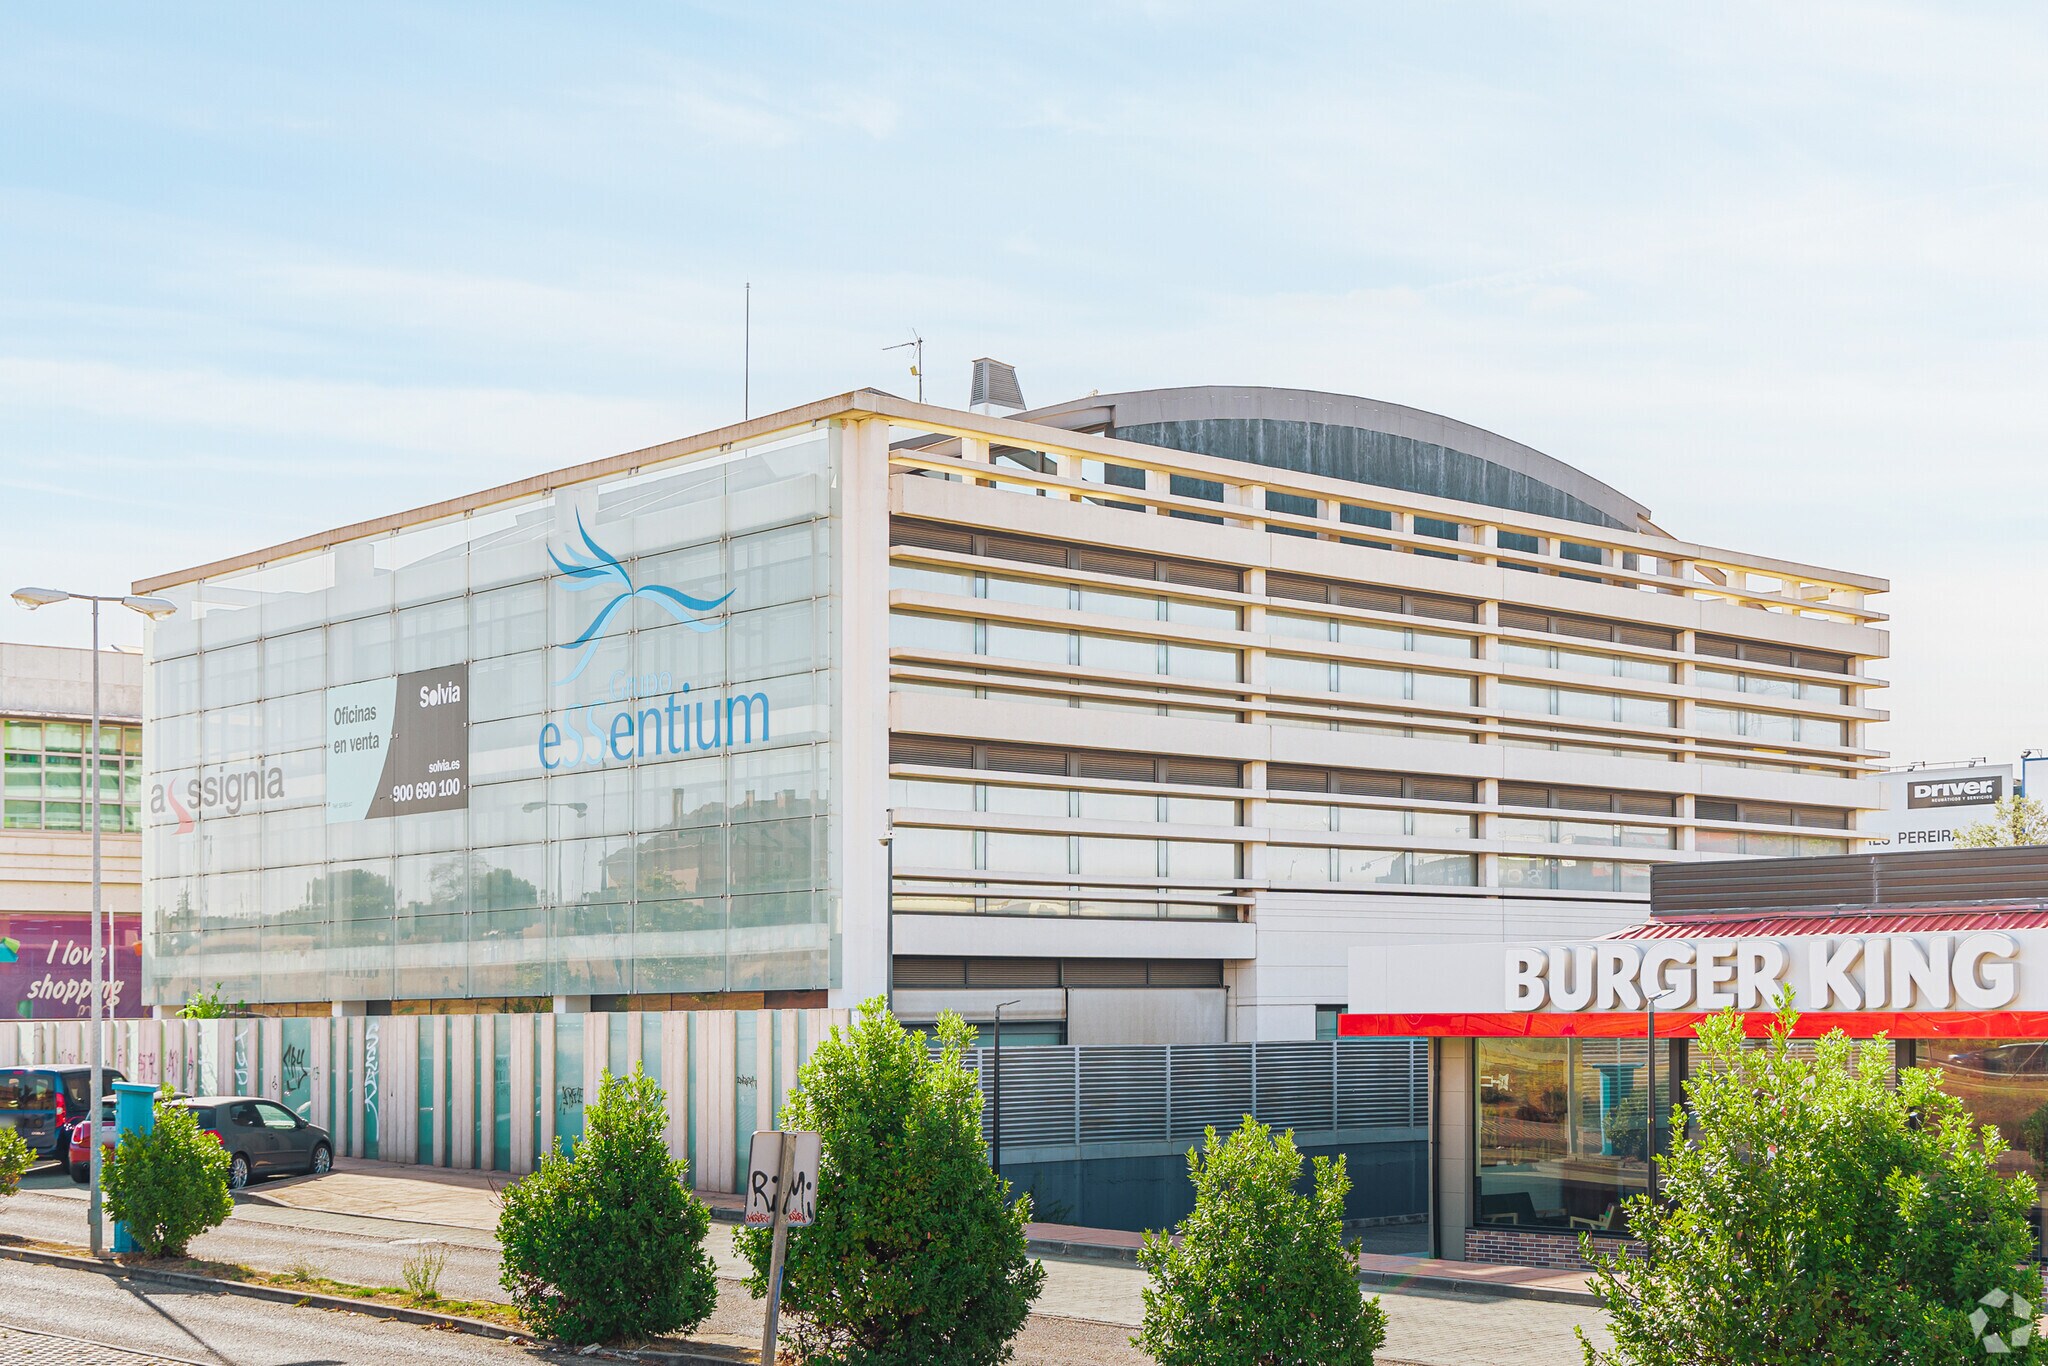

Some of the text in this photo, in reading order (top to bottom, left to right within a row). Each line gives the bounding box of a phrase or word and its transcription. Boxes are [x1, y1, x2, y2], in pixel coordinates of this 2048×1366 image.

[419, 681, 461, 708] Solvia
[609, 669, 672, 705] Grupo
[333, 705, 377, 726] Oficinas
[333, 731, 380, 754] en venta
[428, 758, 461, 773] solvia.es
[392, 777, 460, 803] 900 690 100
[46, 939, 59, 965] I
[1503, 931, 2022, 1013] BURGER KING
[26, 973, 125, 1007] shoppng
